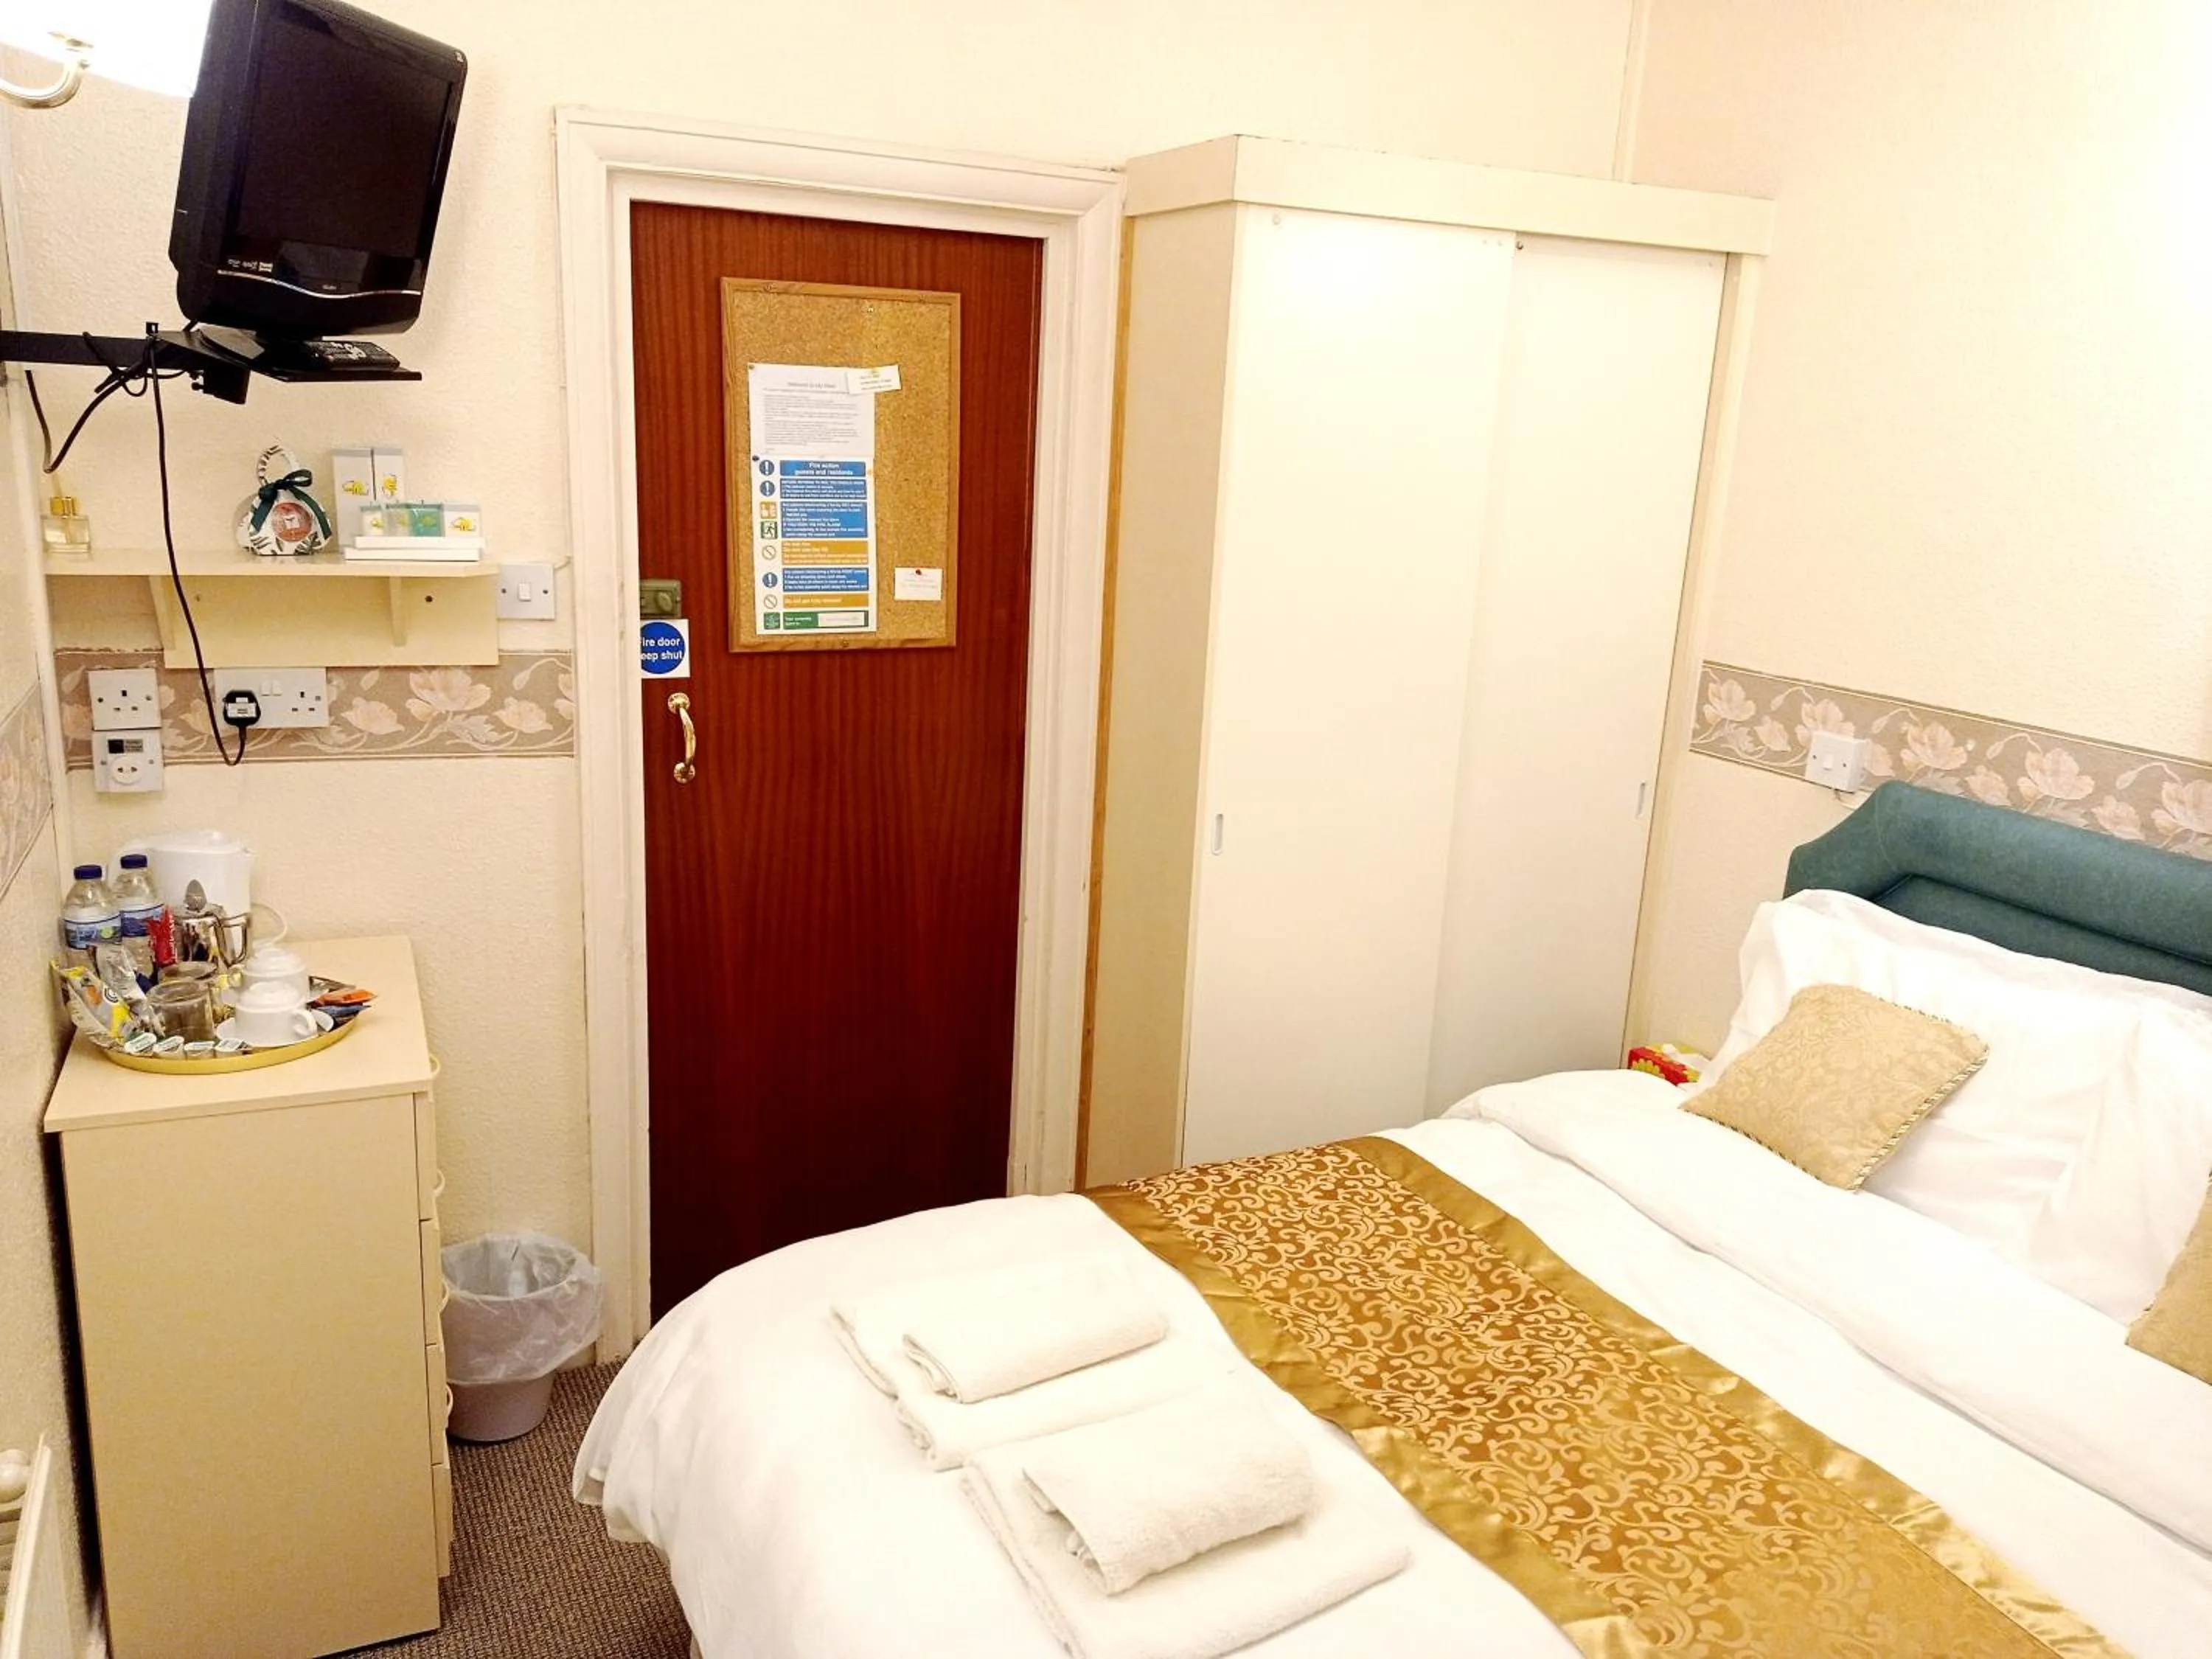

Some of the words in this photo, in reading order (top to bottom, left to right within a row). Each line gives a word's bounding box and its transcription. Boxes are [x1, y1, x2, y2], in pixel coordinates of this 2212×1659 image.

[642, 637, 655, 647] ire
[657, 637, 680, 647] door
[640, 653, 658, 663] eep
[661, 650, 682, 660] shut
